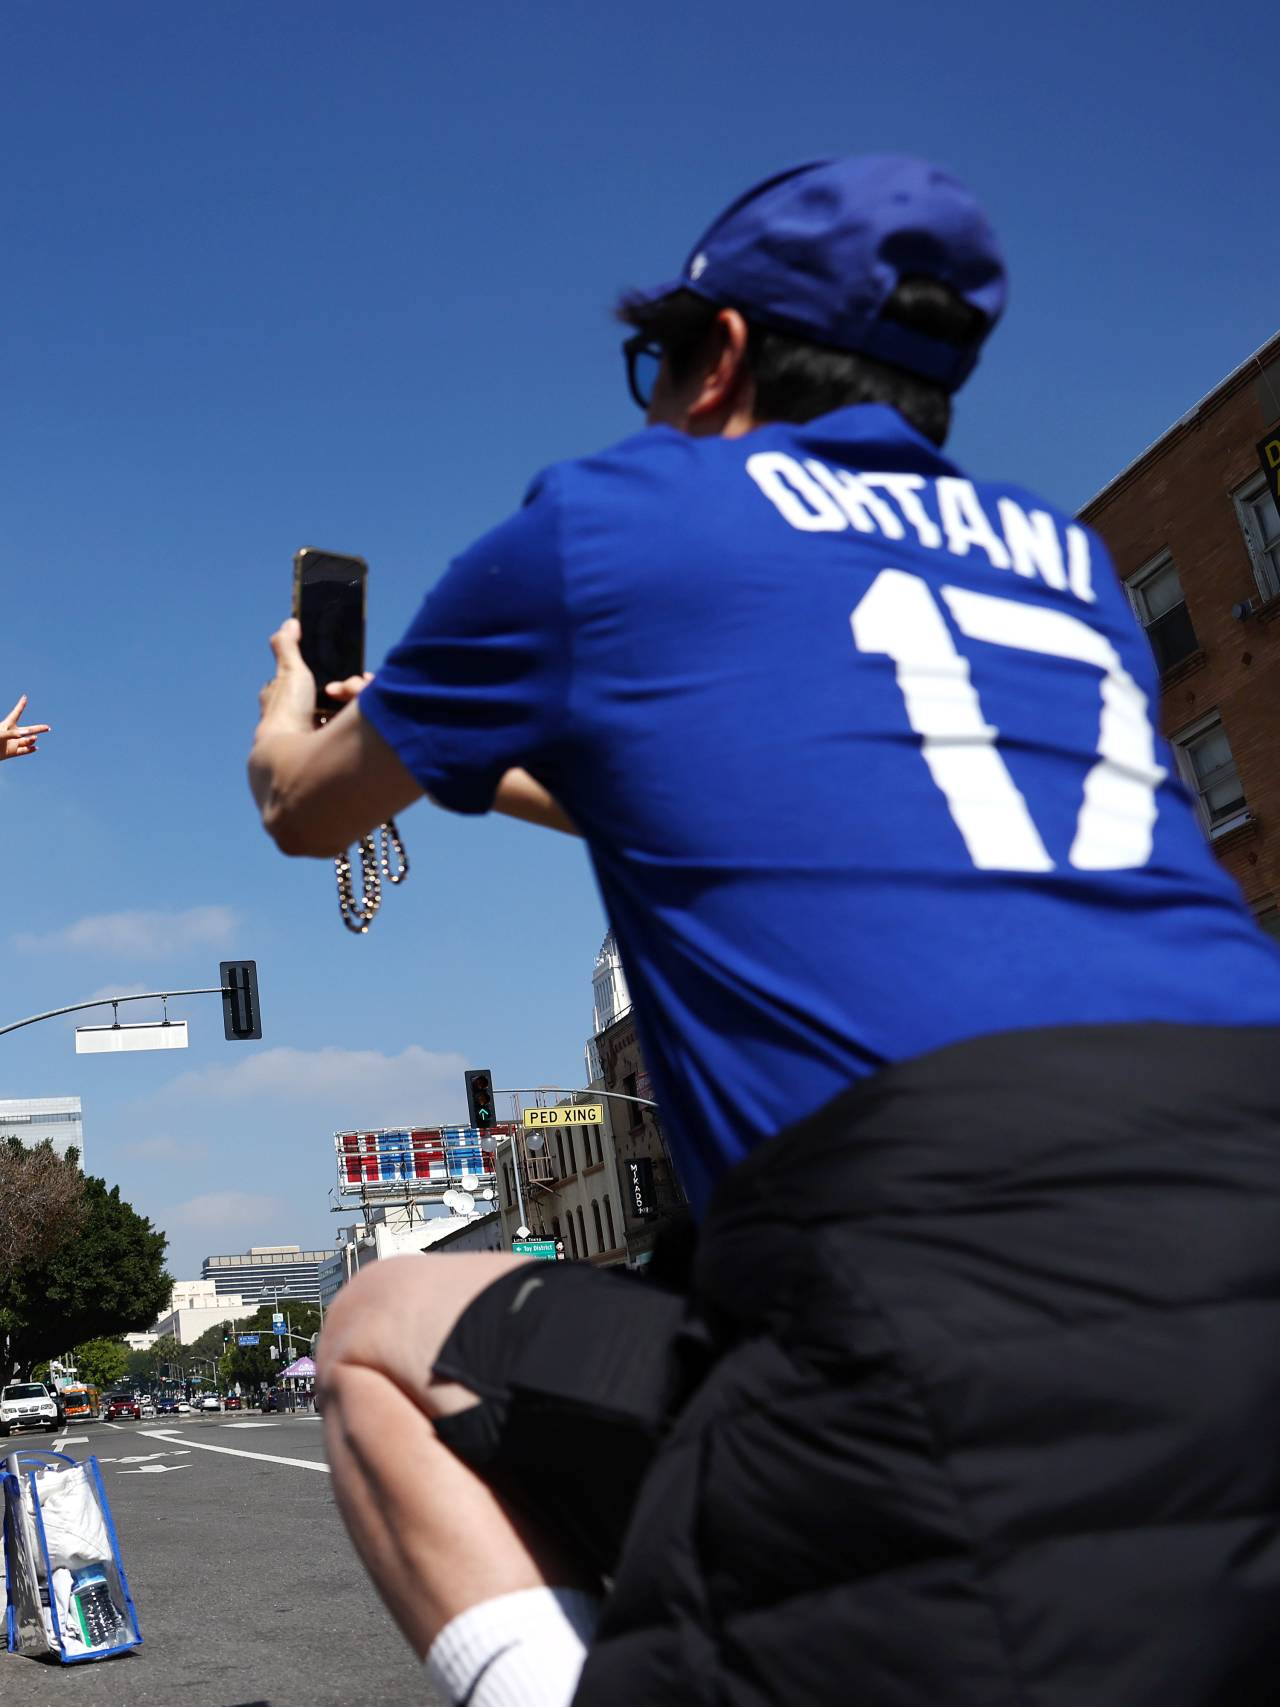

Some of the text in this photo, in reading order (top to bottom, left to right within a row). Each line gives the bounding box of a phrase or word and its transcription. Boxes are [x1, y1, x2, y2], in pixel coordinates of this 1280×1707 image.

[745, 450, 1096, 603] OHTANI
[850, 567, 1168, 872] 17
[530, 1108, 596, 1124] PED XING
[630, 1164, 642, 1207] MIKADO
[533, 1244, 553, 1252] District
